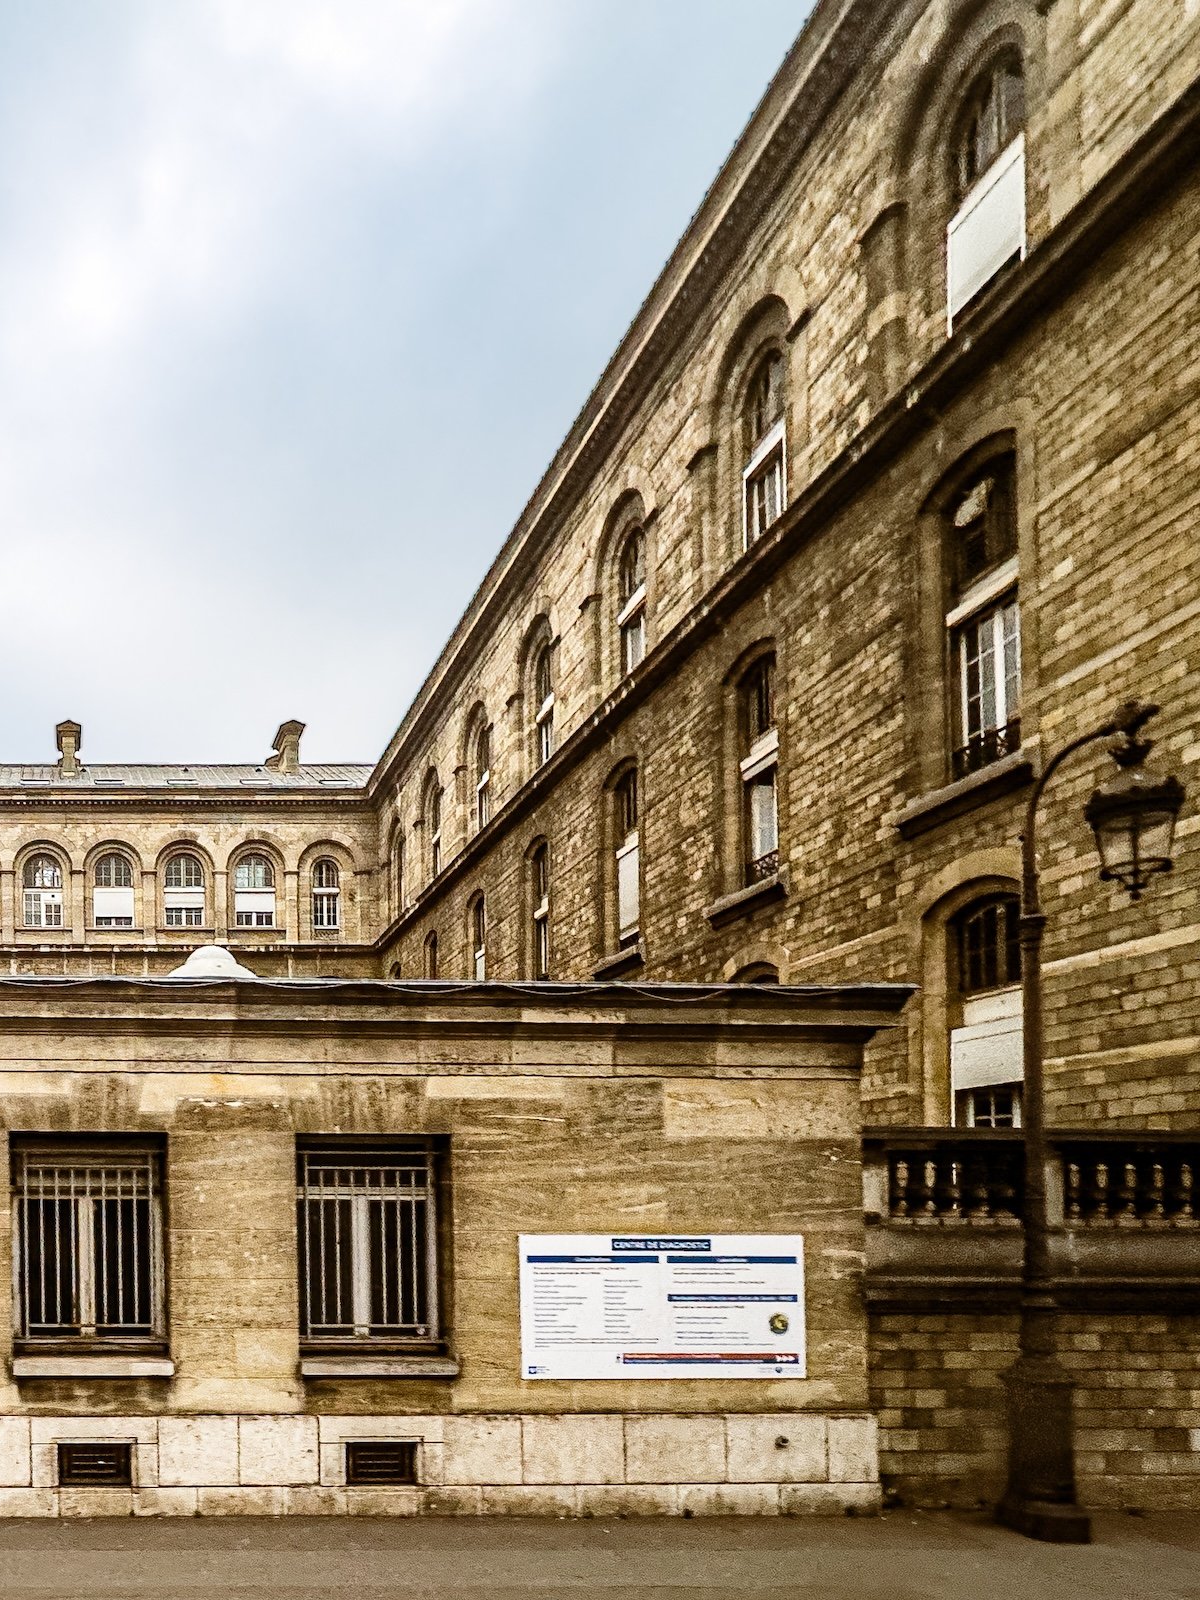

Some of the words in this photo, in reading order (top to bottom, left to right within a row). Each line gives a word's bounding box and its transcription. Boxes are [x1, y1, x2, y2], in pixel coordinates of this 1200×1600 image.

[613, 1241, 646, 1249] CENTRE
[646, 1241, 658, 1249] DE
[659, 1241, 709, 1249] DIAGNOSTIC
